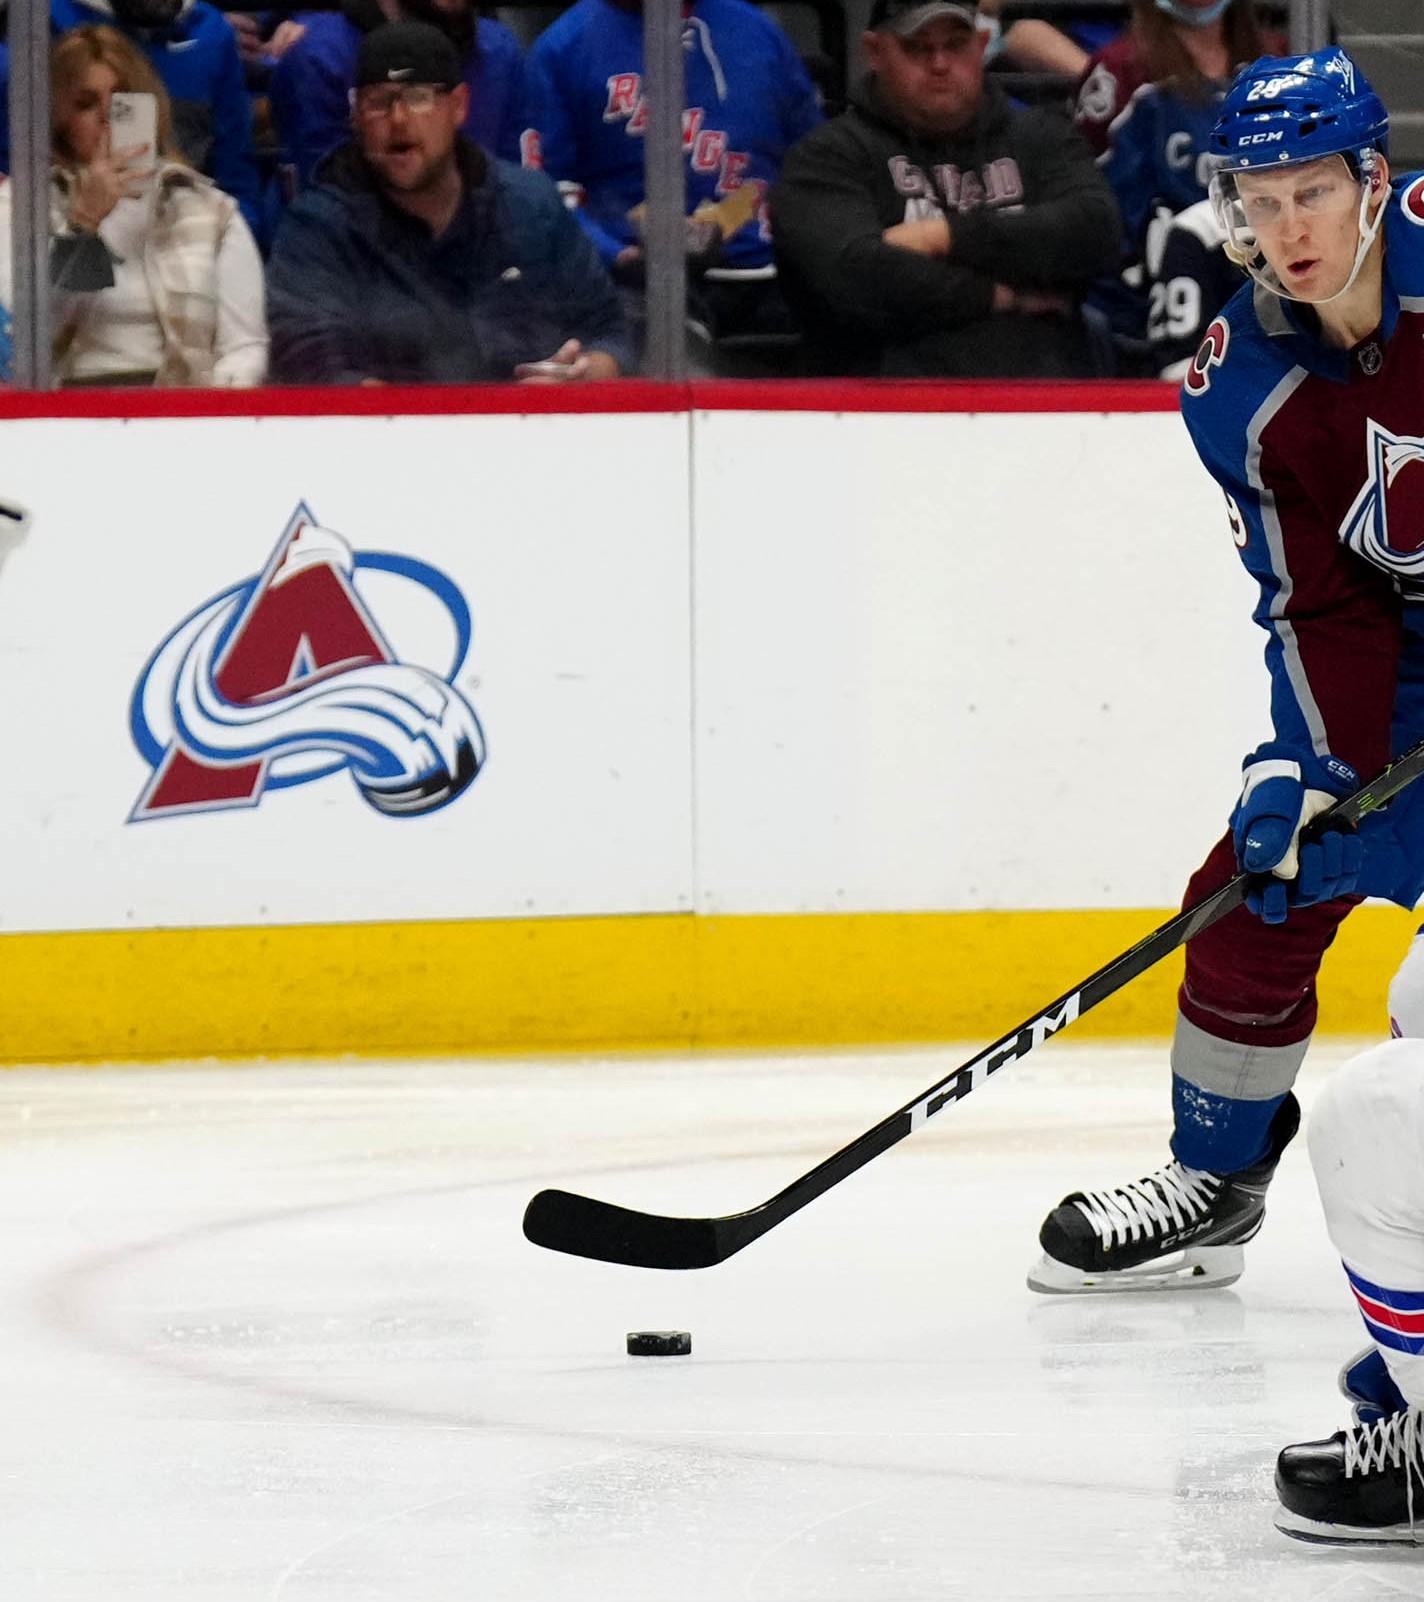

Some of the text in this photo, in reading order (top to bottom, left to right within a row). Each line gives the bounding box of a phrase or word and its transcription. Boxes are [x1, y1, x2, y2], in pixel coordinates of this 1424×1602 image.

[1238, 130, 1284, 147] CCM
[1150, 276, 1200, 339] 29
[905, 990, 1081, 1133] CCM
